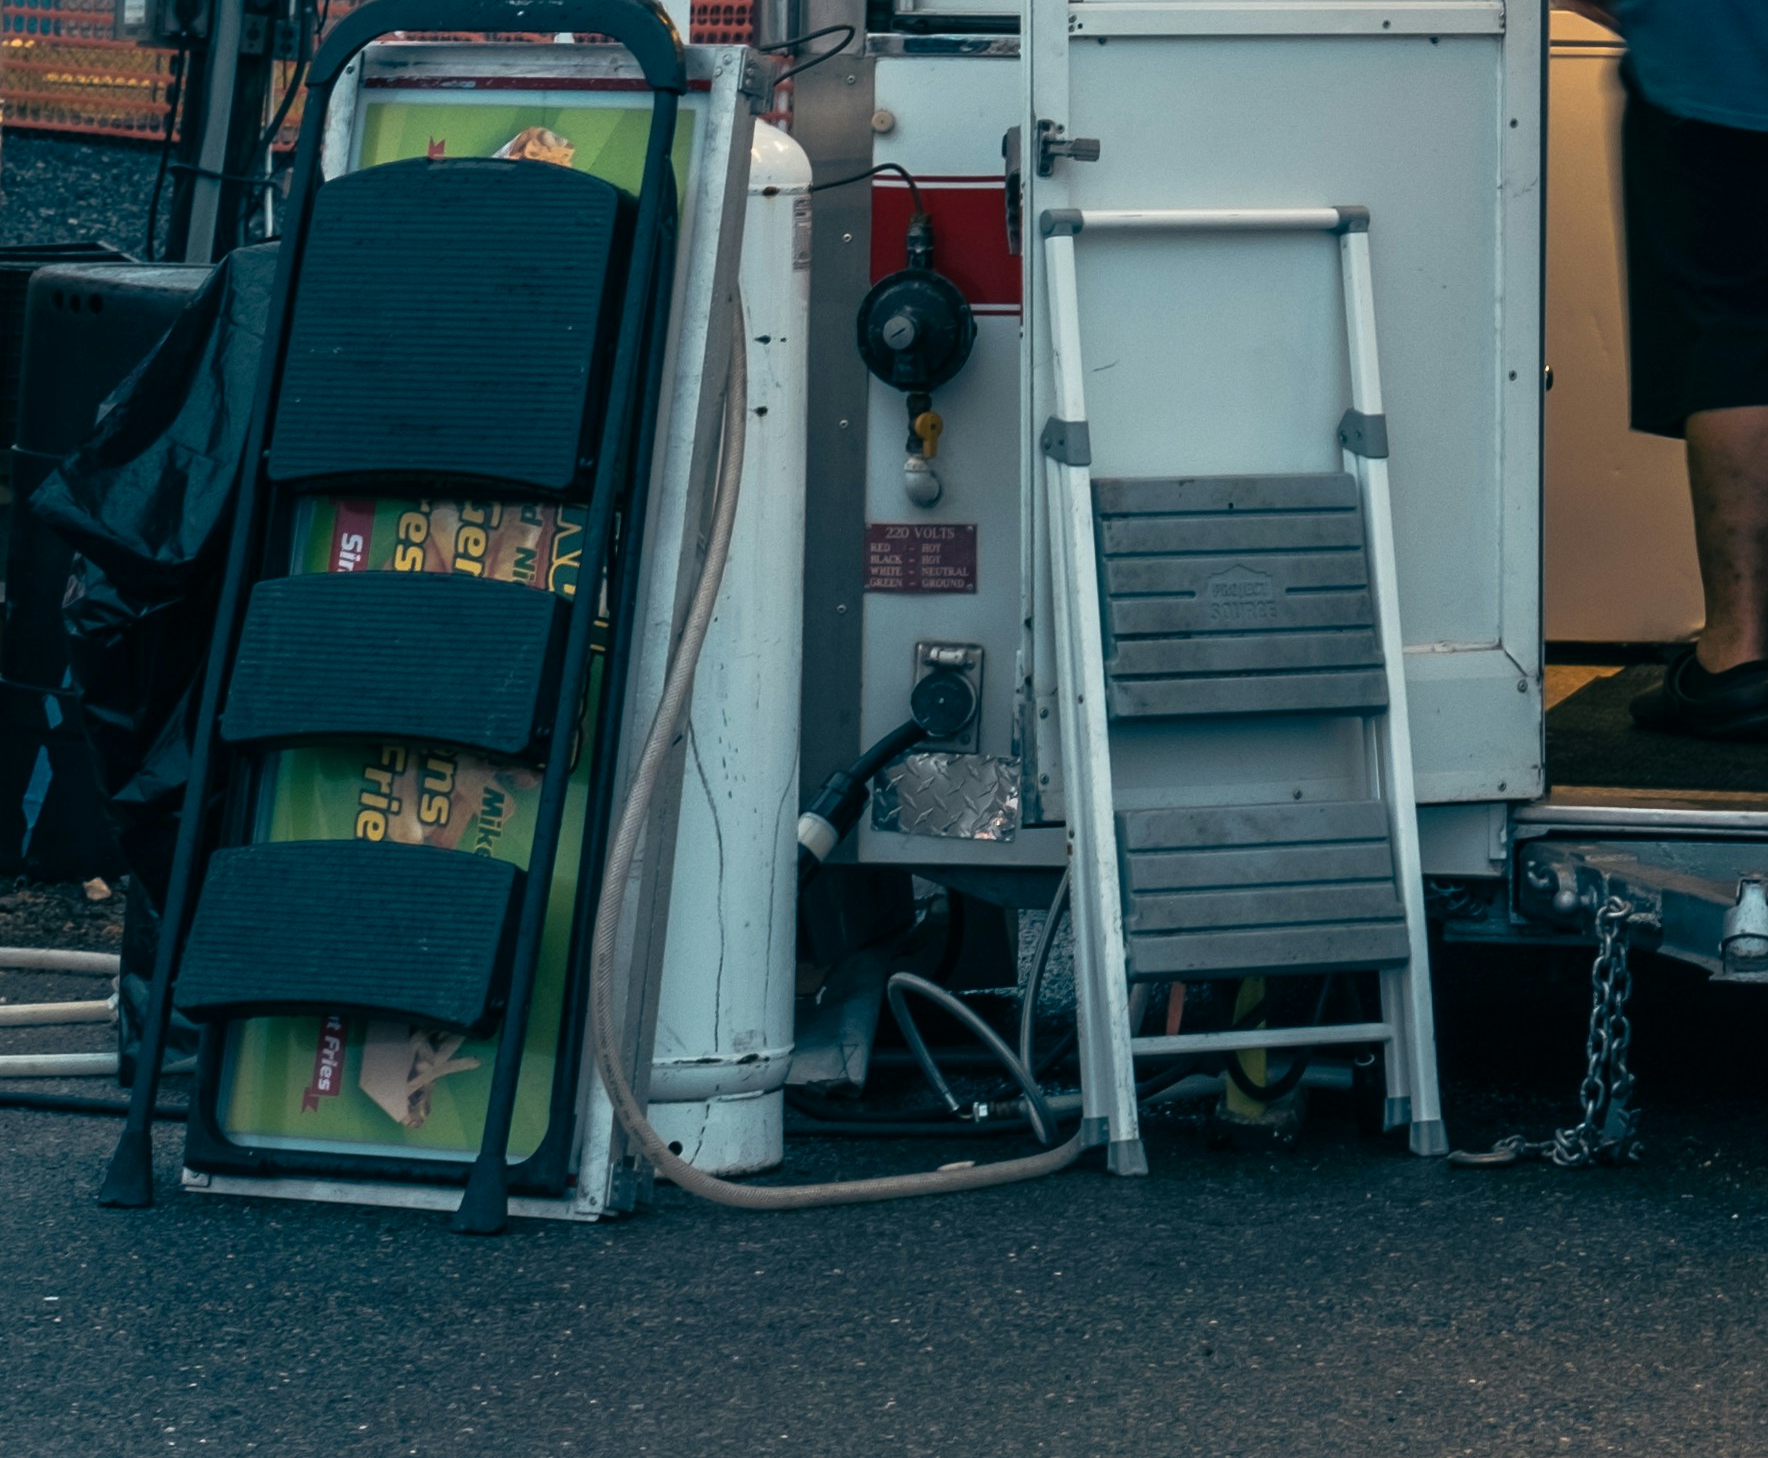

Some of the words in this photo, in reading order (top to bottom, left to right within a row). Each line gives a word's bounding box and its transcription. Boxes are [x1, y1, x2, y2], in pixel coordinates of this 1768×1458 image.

[885, 527, 909, 539] 220
[913, 526, 955, 539] VOLTS
[870, 543, 891, 553] RED
[921, 543, 941, 553] HOT
[870, 554, 903, 564] BLACK
[921, 554, 941, 564] HOT
[870, 566, 902, 576] WHITE
[921, 566, 969, 576] NEUTRAL
[869, 578, 902, 588] GREEN
[921, 578, 965, 588] GROUND
[1210, 600, 1278, 621] SOURCE
[318, 1035, 341, 1092] Fries
